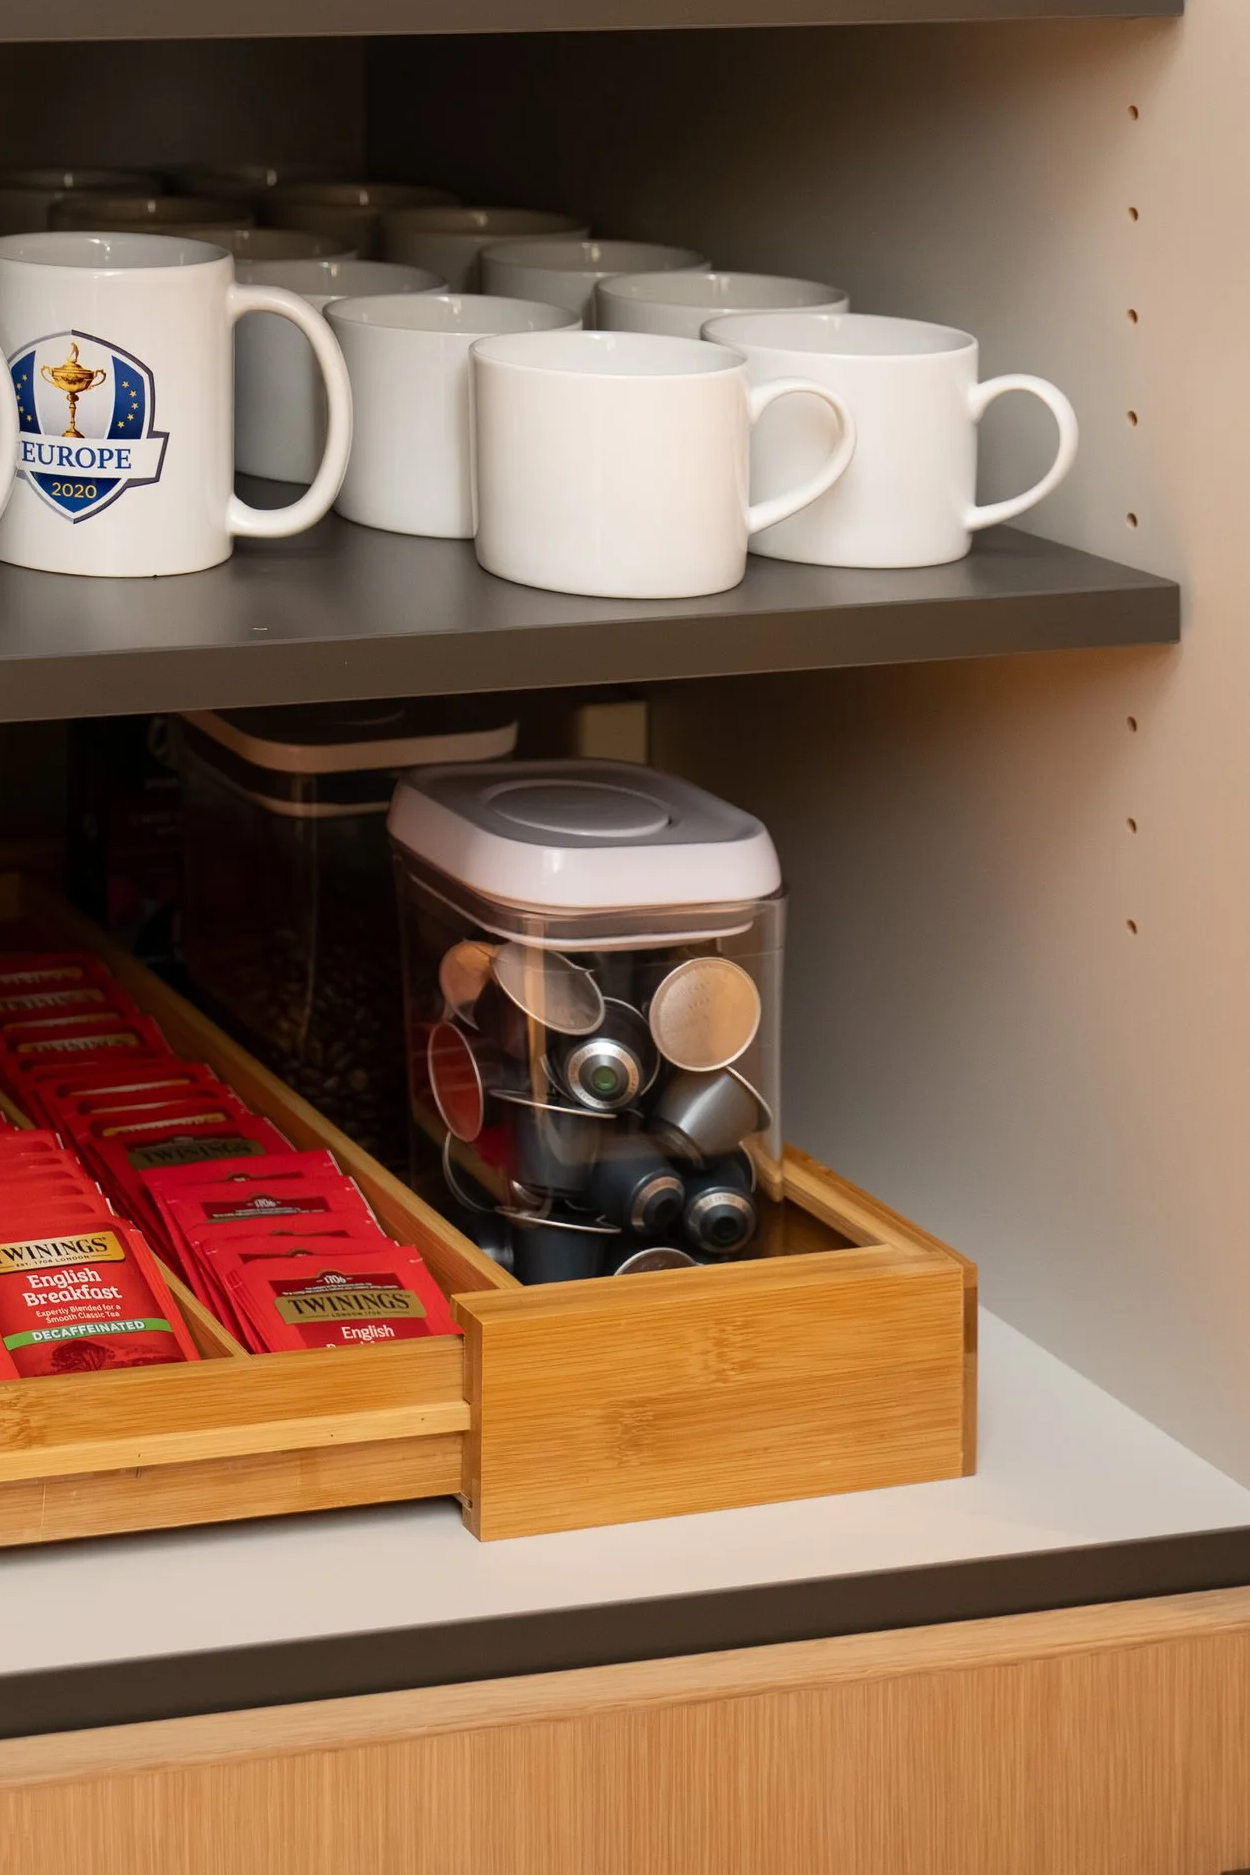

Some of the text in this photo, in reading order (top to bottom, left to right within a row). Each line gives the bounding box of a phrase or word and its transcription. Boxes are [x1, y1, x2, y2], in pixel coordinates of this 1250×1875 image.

[21, 440, 132, 470] EUROPE
[51, 481, 98, 499] 2020
[55, 1255, 90, 1263] LONDON
[26, 1268, 103, 1289] English
[324, 1274, 347, 1285] 1706
[22, 1285, 123, 1307] Breakfast
[287, 1292, 410, 1315] TWININGS
[35, 1307, 70, 1320] Expertly
[70, 1304, 103, 1314] Blended
[103, 1303, 114, 1312] for
[45, 1314, 77, 1324] Smooth
[78, 1312, 105, 1320] Classic
[31, 1320, 146, 1342] DECAFFEINATED
[341, 1324, 395, 1341] English
